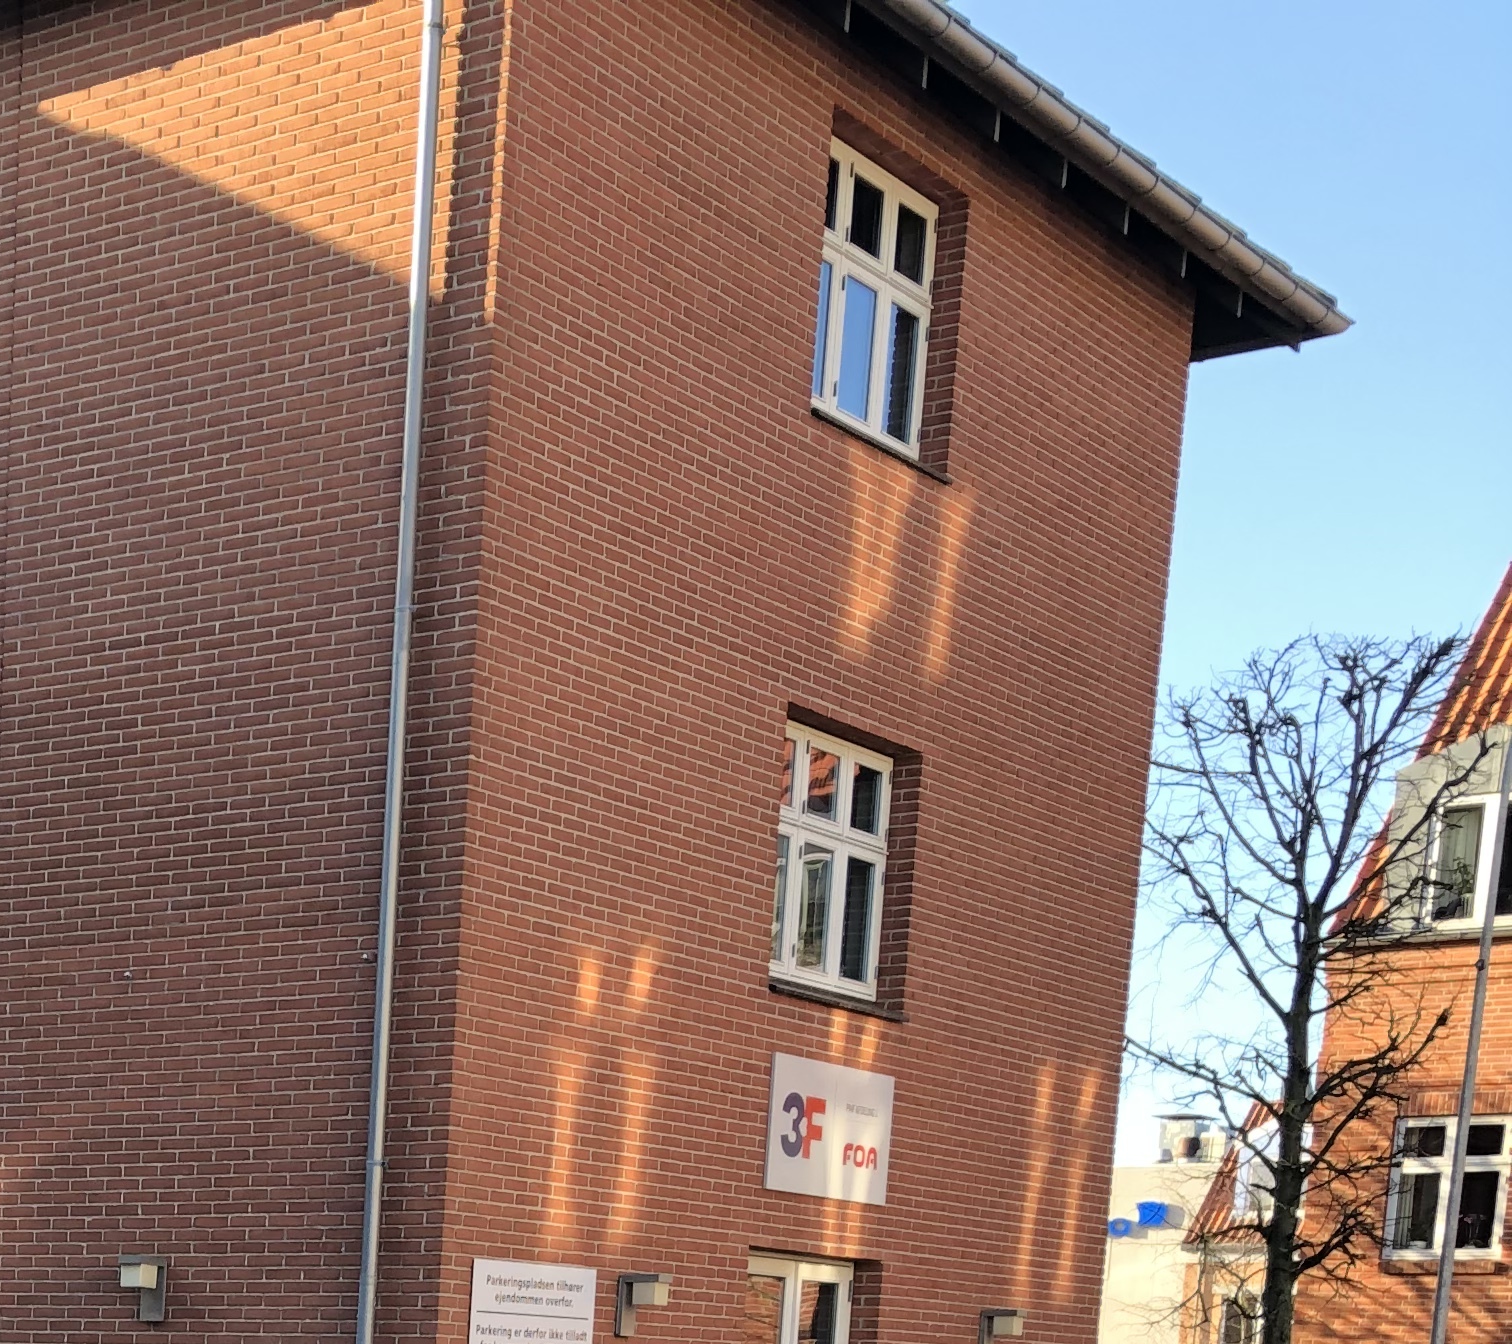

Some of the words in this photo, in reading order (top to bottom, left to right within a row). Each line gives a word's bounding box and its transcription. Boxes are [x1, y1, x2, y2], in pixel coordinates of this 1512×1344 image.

[781, 1092, 826, 1159] 3F
[842, 1142, 878, 1170] FOA
[486, 1274, 555, 1291] Parkeringspladsen
[494, 1291, 544, 1304] ejendommen
[476, 1324, 512, 1339] Parkering
[523, 1327, 547, 1339] derfor
